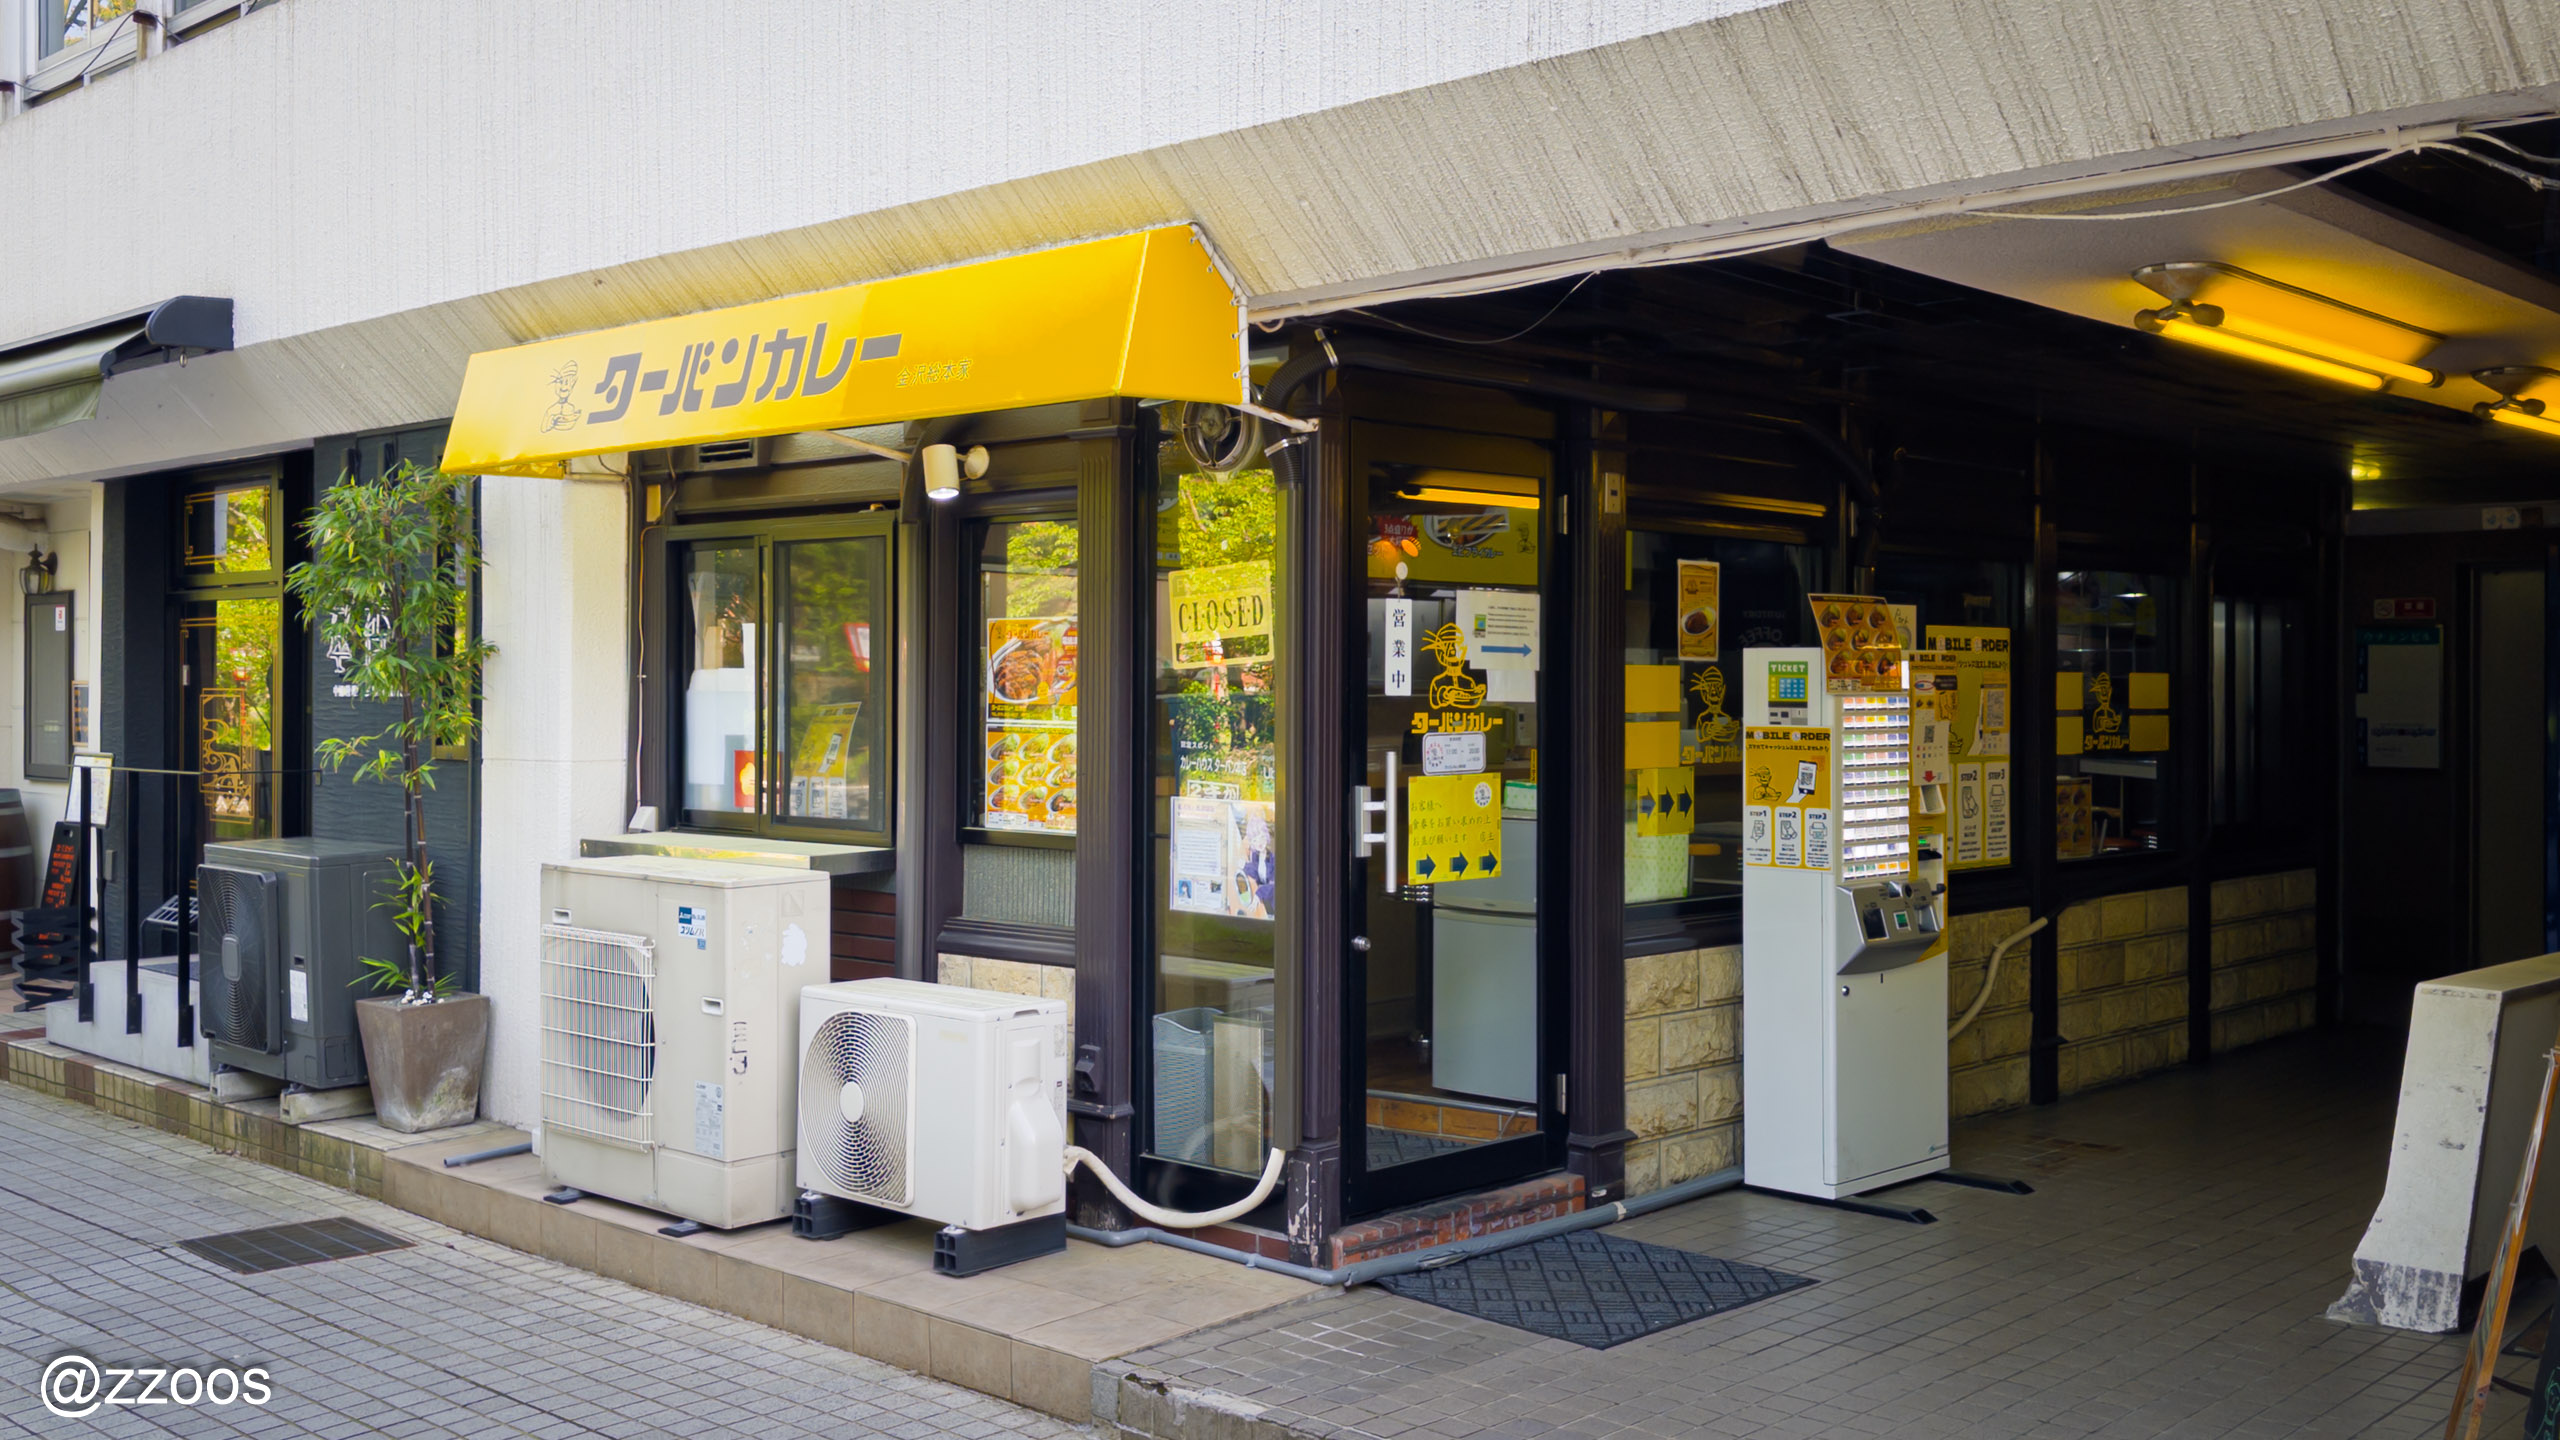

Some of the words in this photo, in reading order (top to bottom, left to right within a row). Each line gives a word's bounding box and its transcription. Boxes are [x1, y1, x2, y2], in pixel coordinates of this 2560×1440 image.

[586, 322, 902, 425] ターバンカレー
[1392, 608, 1407, 689] 営業中
[1770, 664, 1806, 673] TICKET
[1411, 711, 1503, 735] ターバンカレー
[1681, 744, 1743, 765] ターバンカレ
